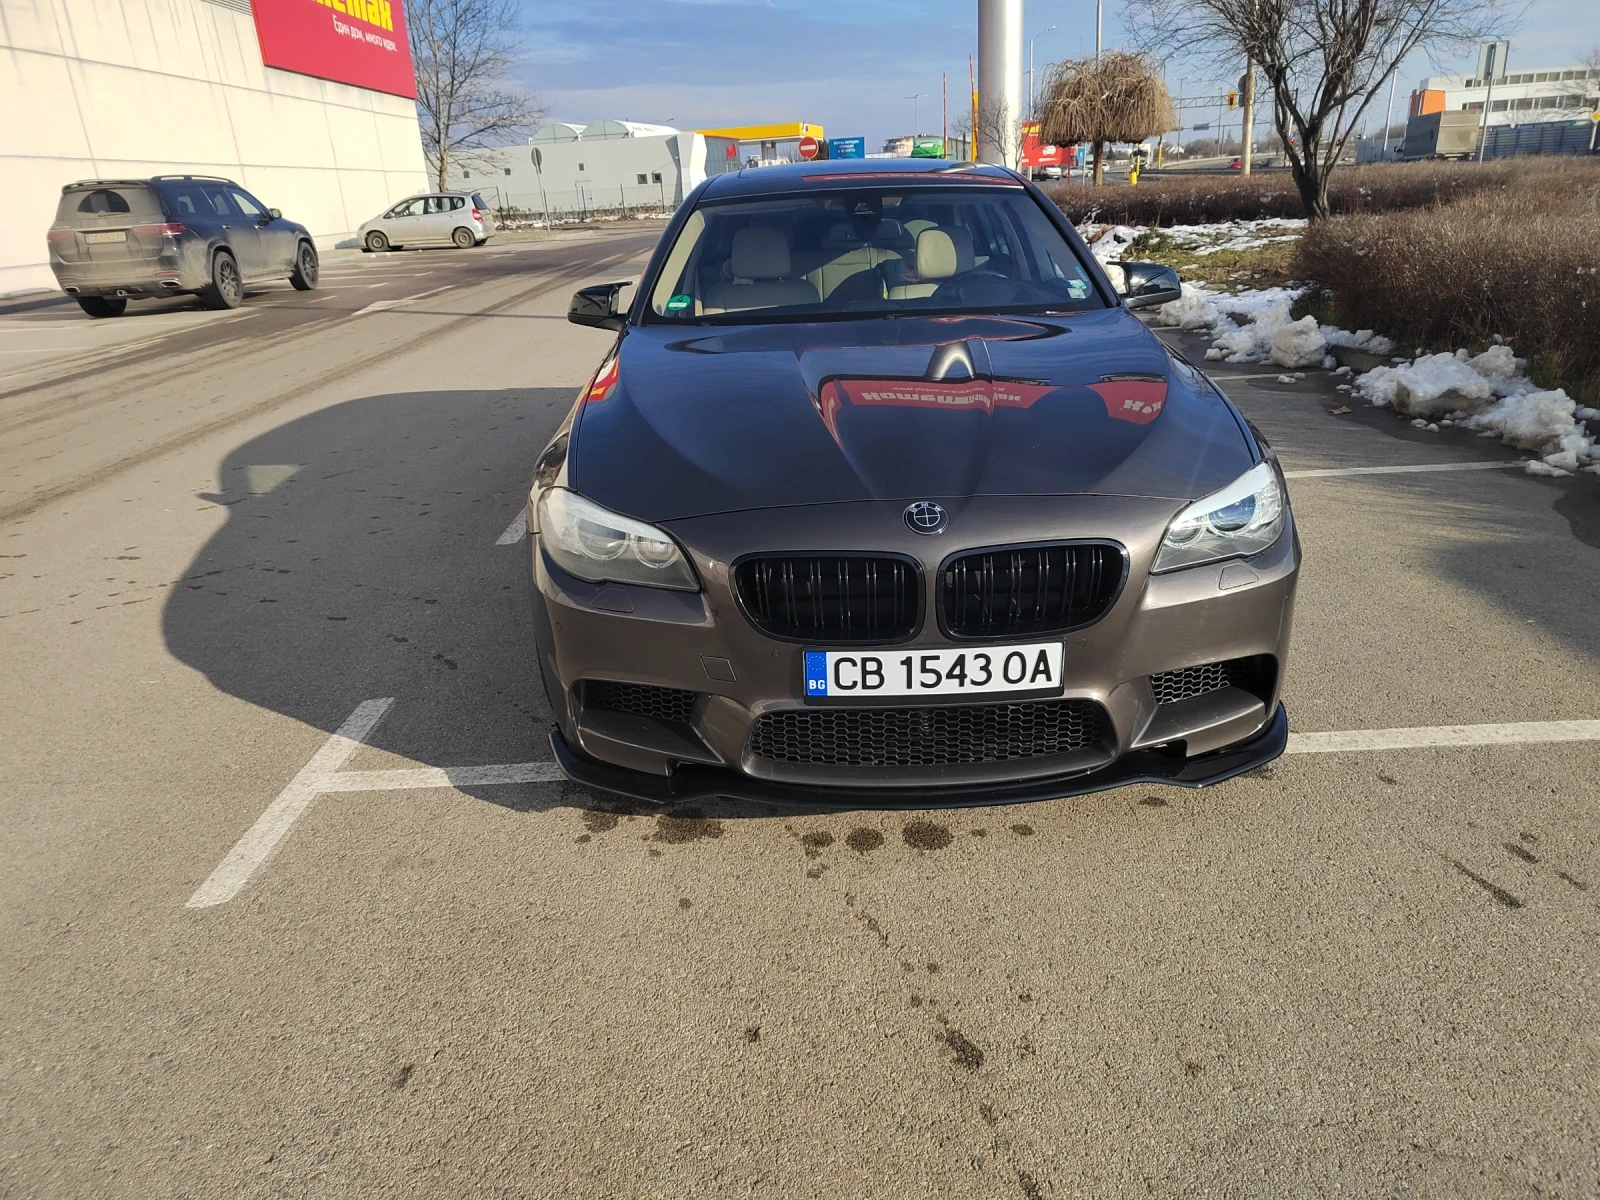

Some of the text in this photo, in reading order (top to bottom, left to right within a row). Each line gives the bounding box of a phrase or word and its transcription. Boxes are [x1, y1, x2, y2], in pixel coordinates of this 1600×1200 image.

[332, 13, 350, 36] Един
[909, 502, 943, 513] BMW
[834, 649, 1053, 690] CB 1543 OA
[808, 680, 826, 690] BG
